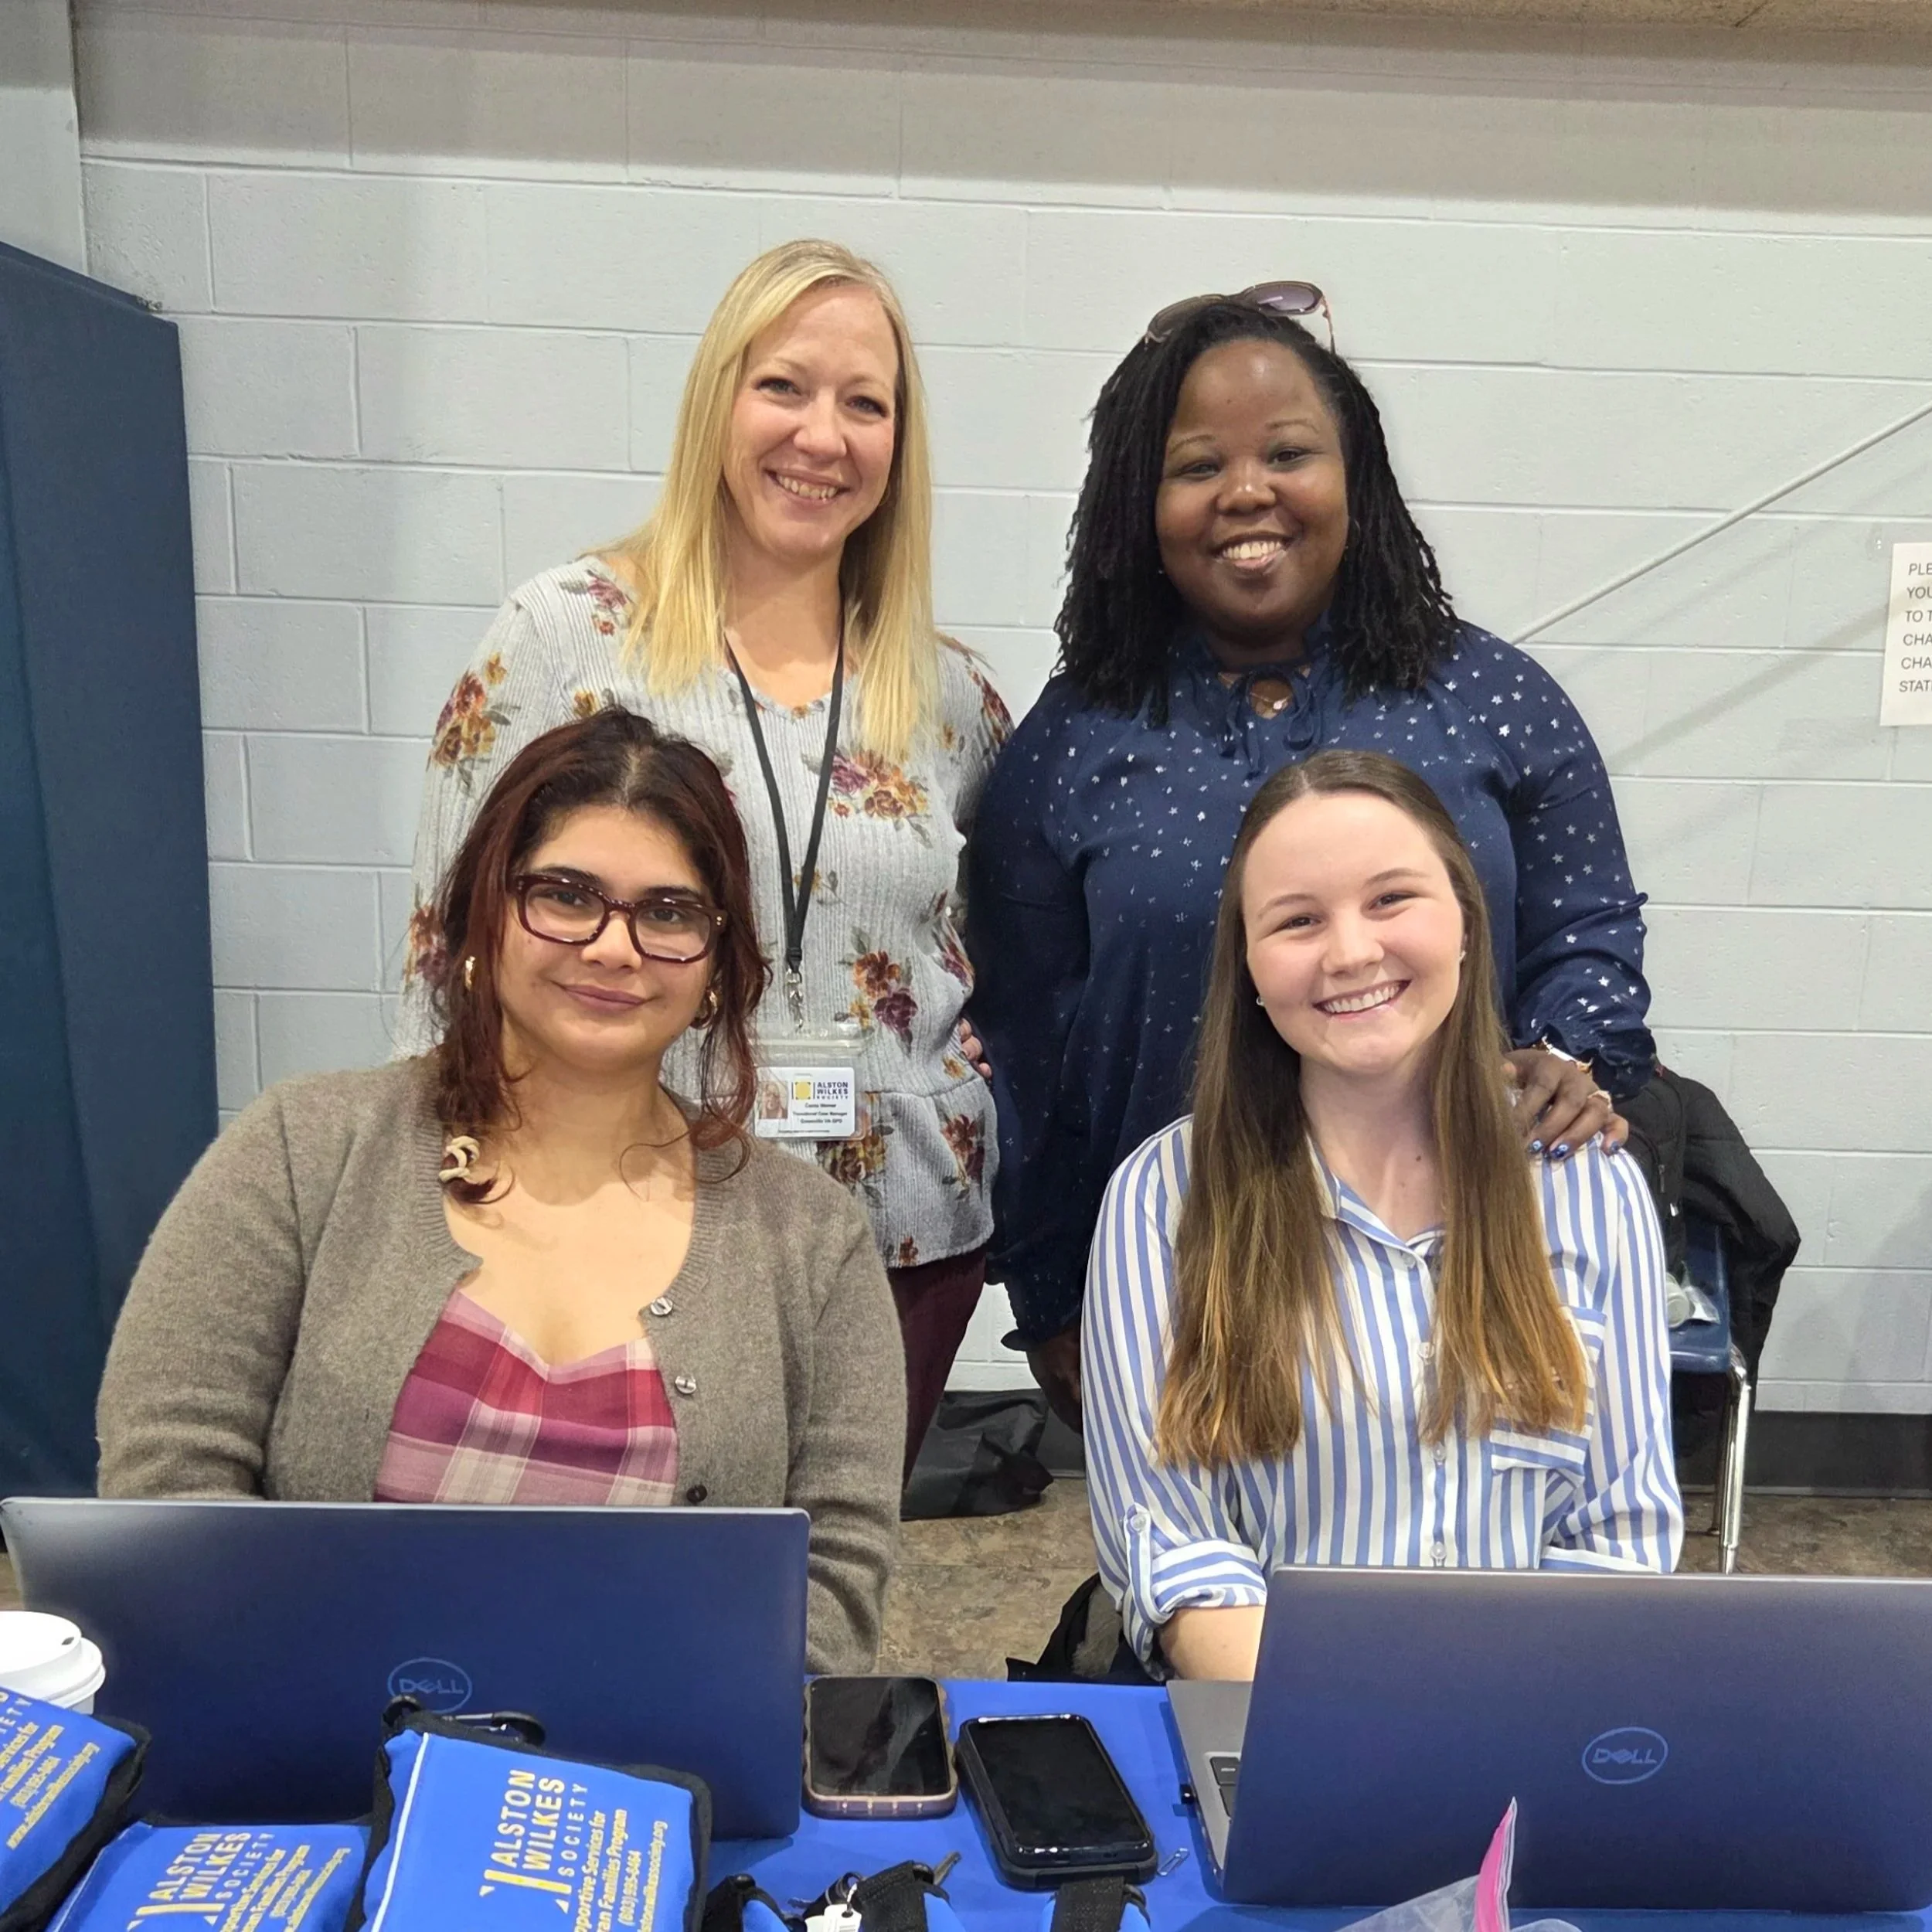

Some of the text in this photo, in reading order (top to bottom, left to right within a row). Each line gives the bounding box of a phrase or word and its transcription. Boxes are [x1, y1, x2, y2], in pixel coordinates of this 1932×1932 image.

[1908, 563, 1932, 576] PLE
[1906, 610, 1923, 623] TO
[1899, 680, 1932, 692] STAT
[1901, 657, 1932, 670] CHA
[399, 1679, 464, 1694] DELL
[1592, 1748, 1658, 1764] DELL
[491, 1770, 536, 1868] ALSTON
[522, 1777, 565, 1870] WILKES
[557, 1783, 587, 1877] SOCIETY
[606, 1808, 629, 1858] Program
[148, 1833, 223, 1901] ALSTON
[179, 1832, 252, 1900] WILKES
[215, 1833, 275, 1900] SOCIETY
